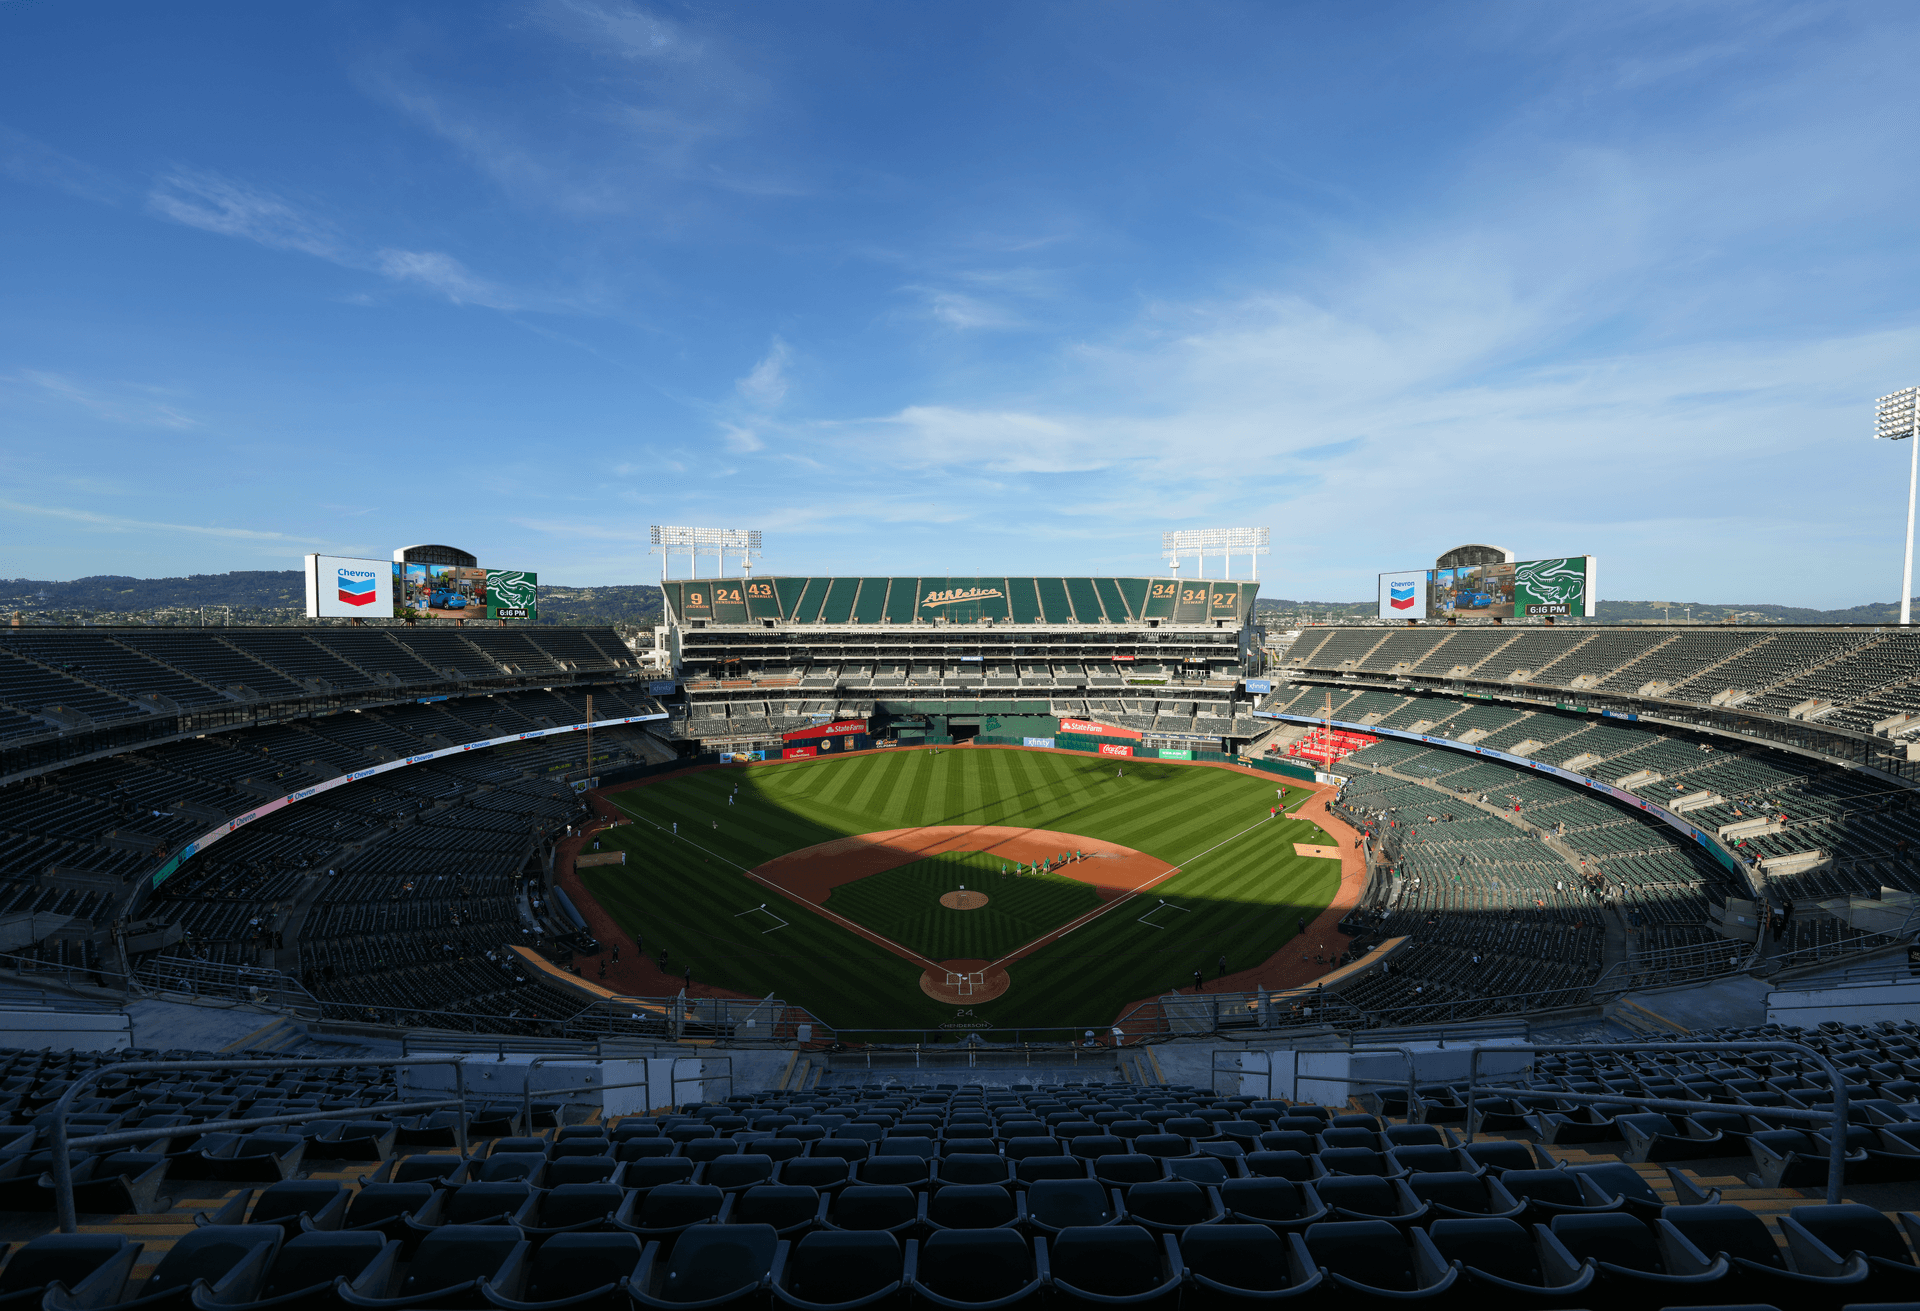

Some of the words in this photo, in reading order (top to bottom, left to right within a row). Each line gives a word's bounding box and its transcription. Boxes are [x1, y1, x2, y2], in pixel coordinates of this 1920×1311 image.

[337, 568, 376, 578] Chevron
[748, 583, 772, 595] 43
[1152, 584, 1175, 596] 34
[690, 593, 703, 605] 9
[716, 589, 741, 601] 24
[920, 587, 1003, 606] Athletics
[1182, 589, 1206, 601] 34
[1212, 593, 1237, 605] 27
[514, 609, 526, 617] PM
[1530, 605, 1548, 614] 6:16
[1549, 605, 1566, 613] PM
[1248, 683, 1268, 691] xfinity
[1326, 719, 1344, 727] Cevron
[1376, 727, 1394, 735] Chevron
[471, 741, 491, 749] Chevron
[1028, 738, 1050, 748] xfinity
[1428, 736, 1447, 745] Chevron
[1102, 744, 1128, 756] Coca-Cola
[1482, 748, 1501, 758] Chevron
[413, 752, 434, 762] Chevron
[1537, 763, 1557, 774] Chevron
[353, 769, 376, 779] Chevron
[1592, 781, 1613, 794] Chevron
[294, 787, 316, 800] Chevron
[1647, 803, 1665, 819] Chevron
[235, 812, 257, 827] Chevron
[957, 1008, 974, 1017] 24
